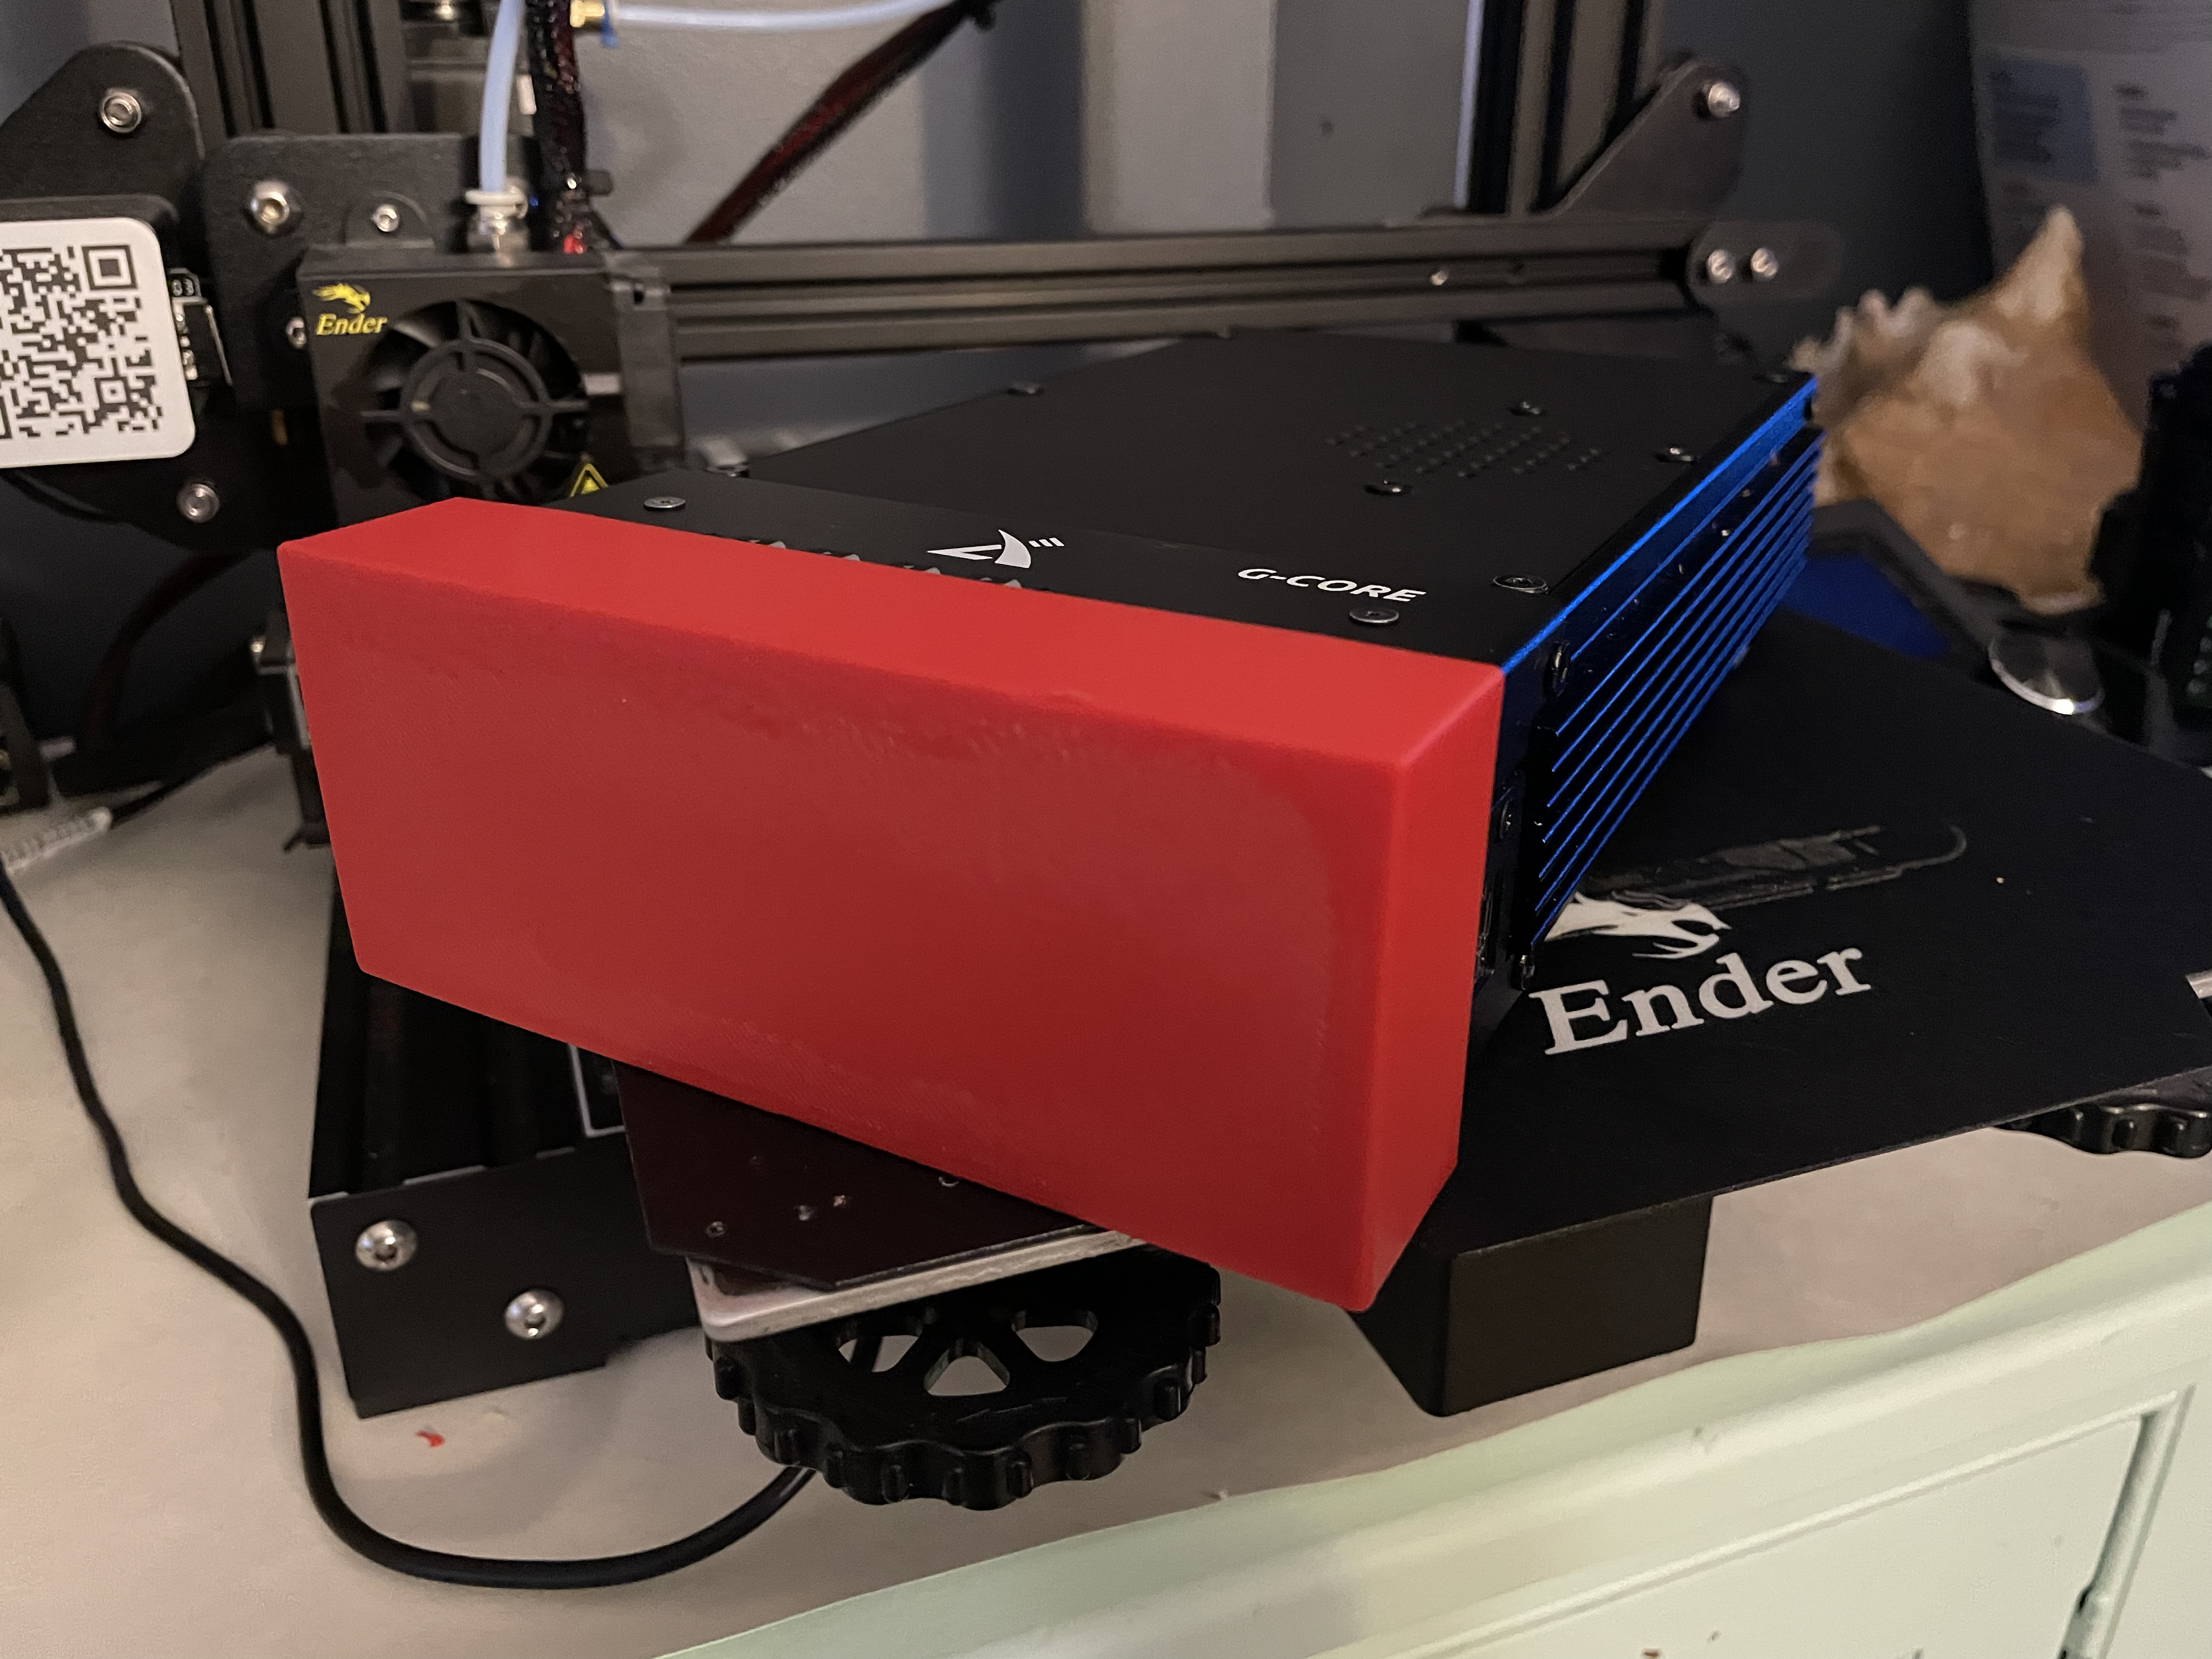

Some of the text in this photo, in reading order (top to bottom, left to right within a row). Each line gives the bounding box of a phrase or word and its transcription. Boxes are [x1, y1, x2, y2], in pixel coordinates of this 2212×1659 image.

[315, 312, 387, 336] Ender
[1237, 568, 1426, 602] G-CORE
[1528, 947, 1872, 1055] Ender
